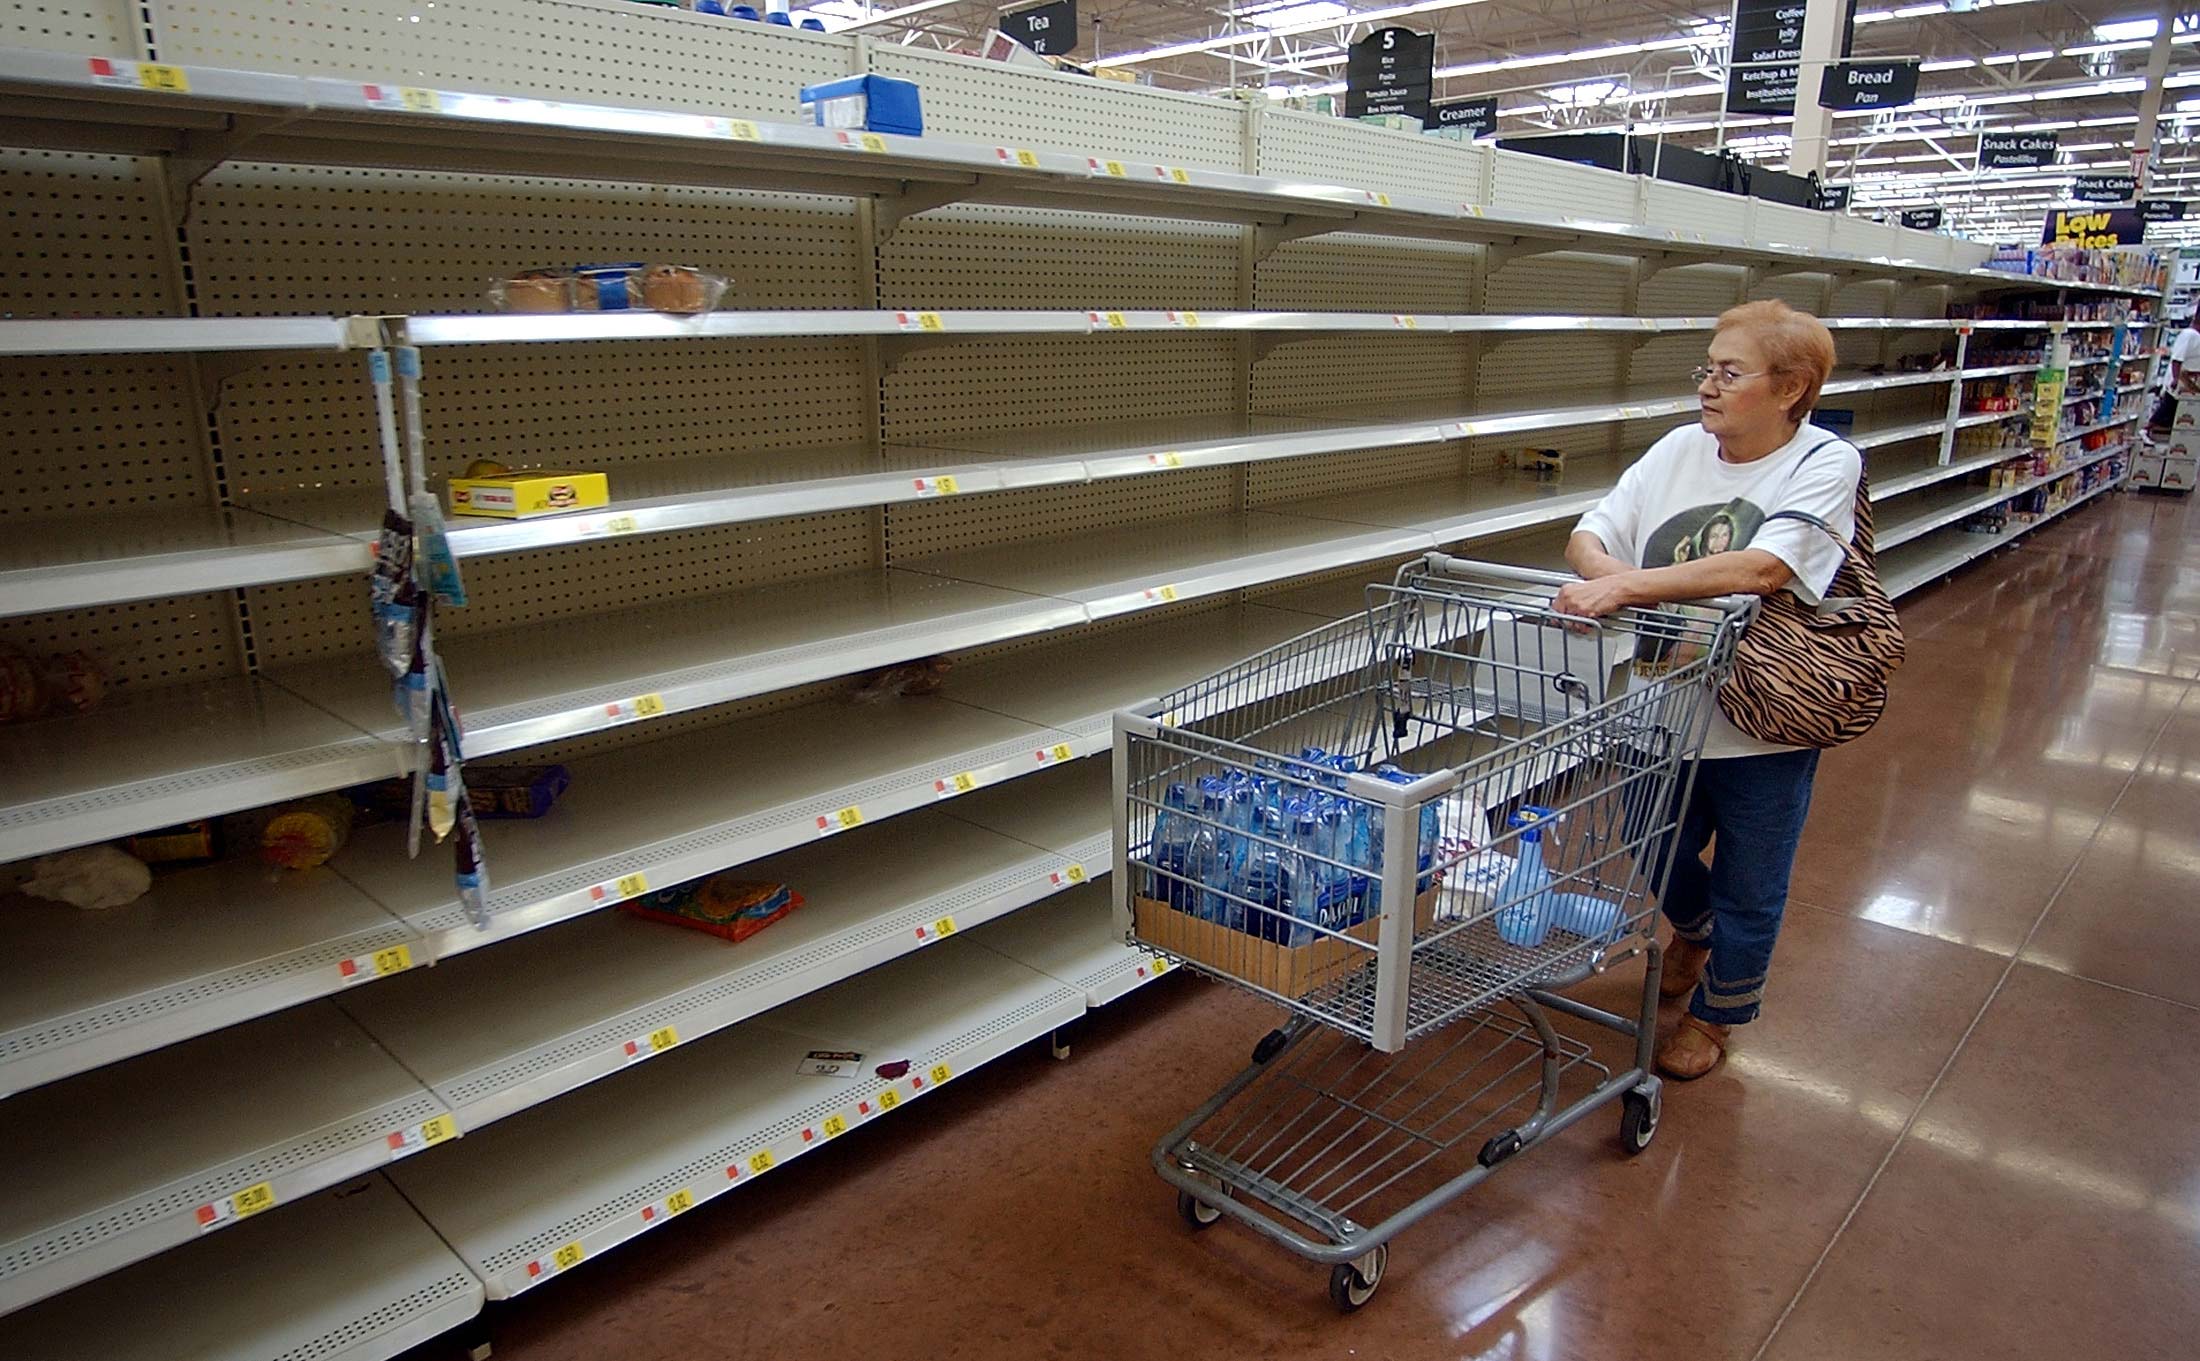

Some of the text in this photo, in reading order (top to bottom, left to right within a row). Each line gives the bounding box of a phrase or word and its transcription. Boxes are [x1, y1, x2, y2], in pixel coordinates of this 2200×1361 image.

[1027, 16, 1050, 31] Tea
[1383, 31, 1395, 49] 5
[1752, 50, 1776, 61] Salad
[1742, 70, 1778, 82] Ketchup
[1779, 69, 1788, 78] &
[1848, 69, 1894, 85] Bread
[1365, 90, 1389, 98] Tomato
[1855, 91, 1879, 104] Pan
[1380, 104, 1405, 112] Dinners
[1439, 107, 1487, 121] Creamer
[1983, 138, 2054, 150] Snack Cakes
[2077, 179, 2135, 189] Snack Cakes
[2056, 211, 2112, 233] Low
